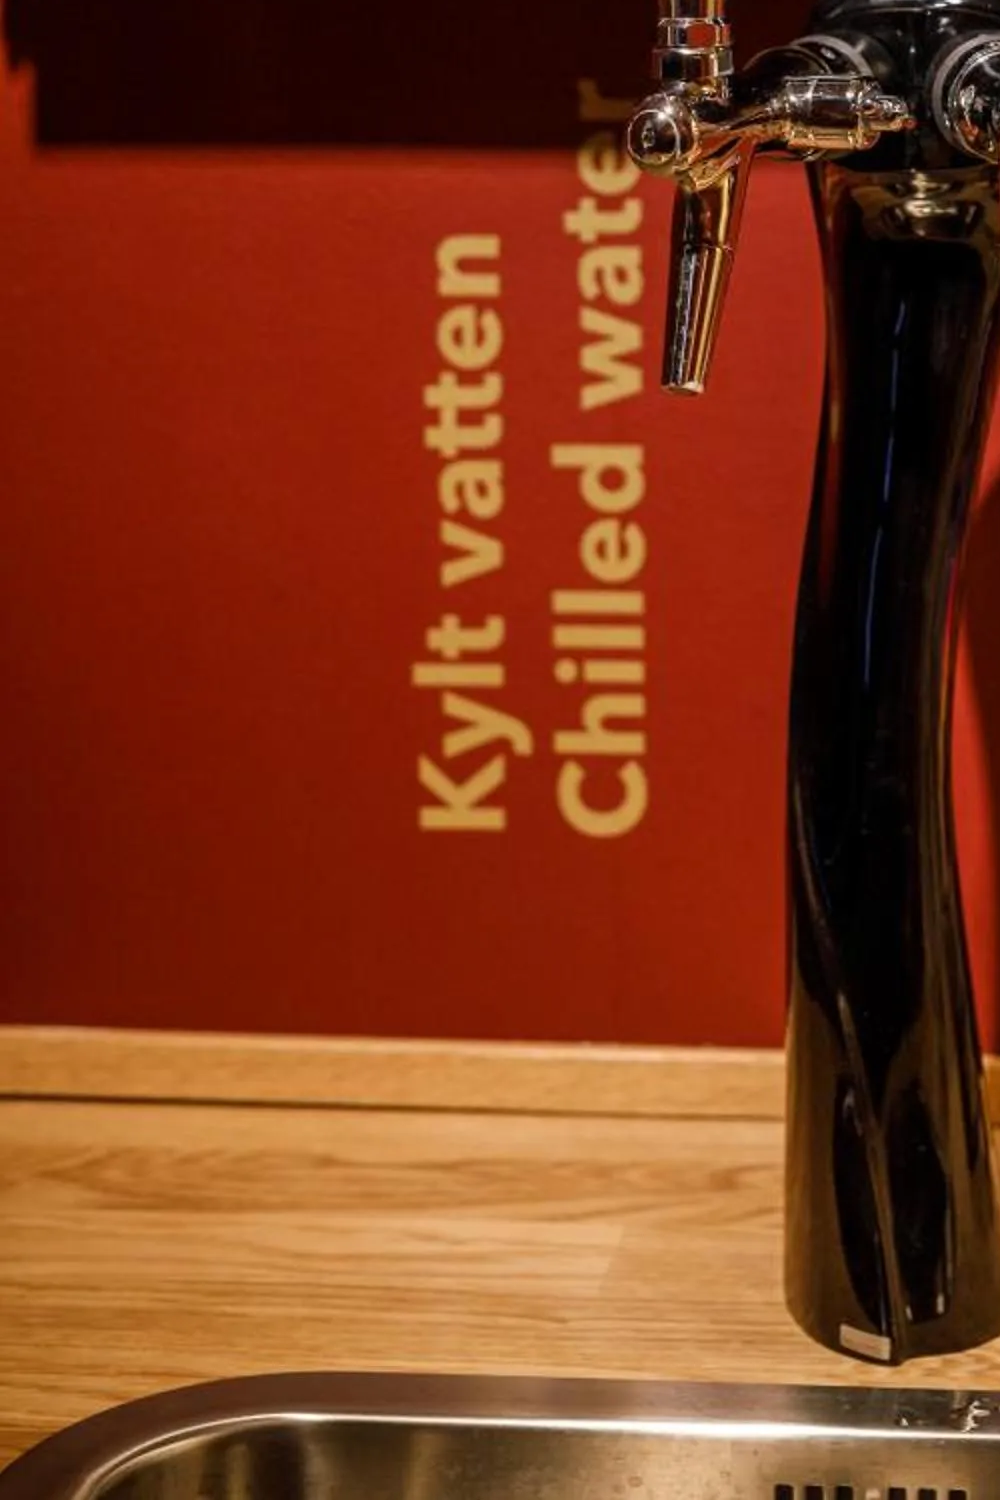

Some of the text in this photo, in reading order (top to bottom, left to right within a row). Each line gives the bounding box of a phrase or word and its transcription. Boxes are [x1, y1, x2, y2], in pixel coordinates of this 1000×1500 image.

[410, 233, 534, 832] Kylt vatten
[549, 78, 649, 840] Chilled water
